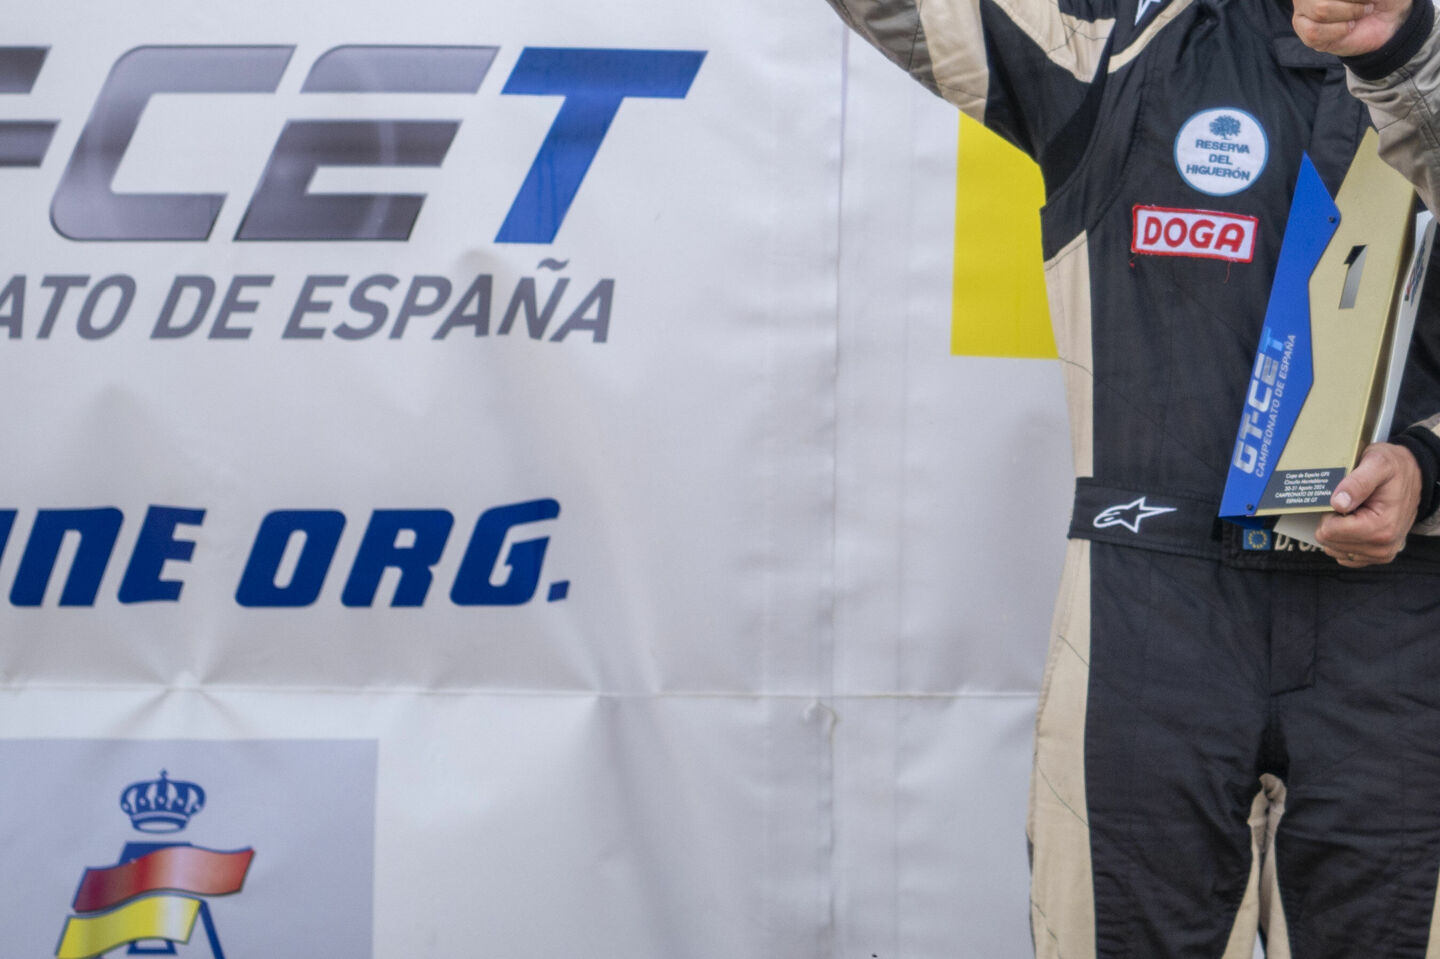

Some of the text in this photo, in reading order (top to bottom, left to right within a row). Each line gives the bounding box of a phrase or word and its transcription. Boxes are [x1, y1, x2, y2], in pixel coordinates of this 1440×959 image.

[1186, 164, 1250, 182] HIGUERÓN
[1195, 138, 1250, 154] RESERVA
[1208, 153, 1233, 166] DEL
[1142, 216, 1245, 253] DOGA
[149, 273, 275, 340] DE
[281, 258, 617, 344] ESPAÑA
[1233, 326, 1284, 475] GT-CET
[1255, 333, 1297, 479] CAMPEONATO DE ESPAÑA
[0, 497, 572, 608] NE ORG.
